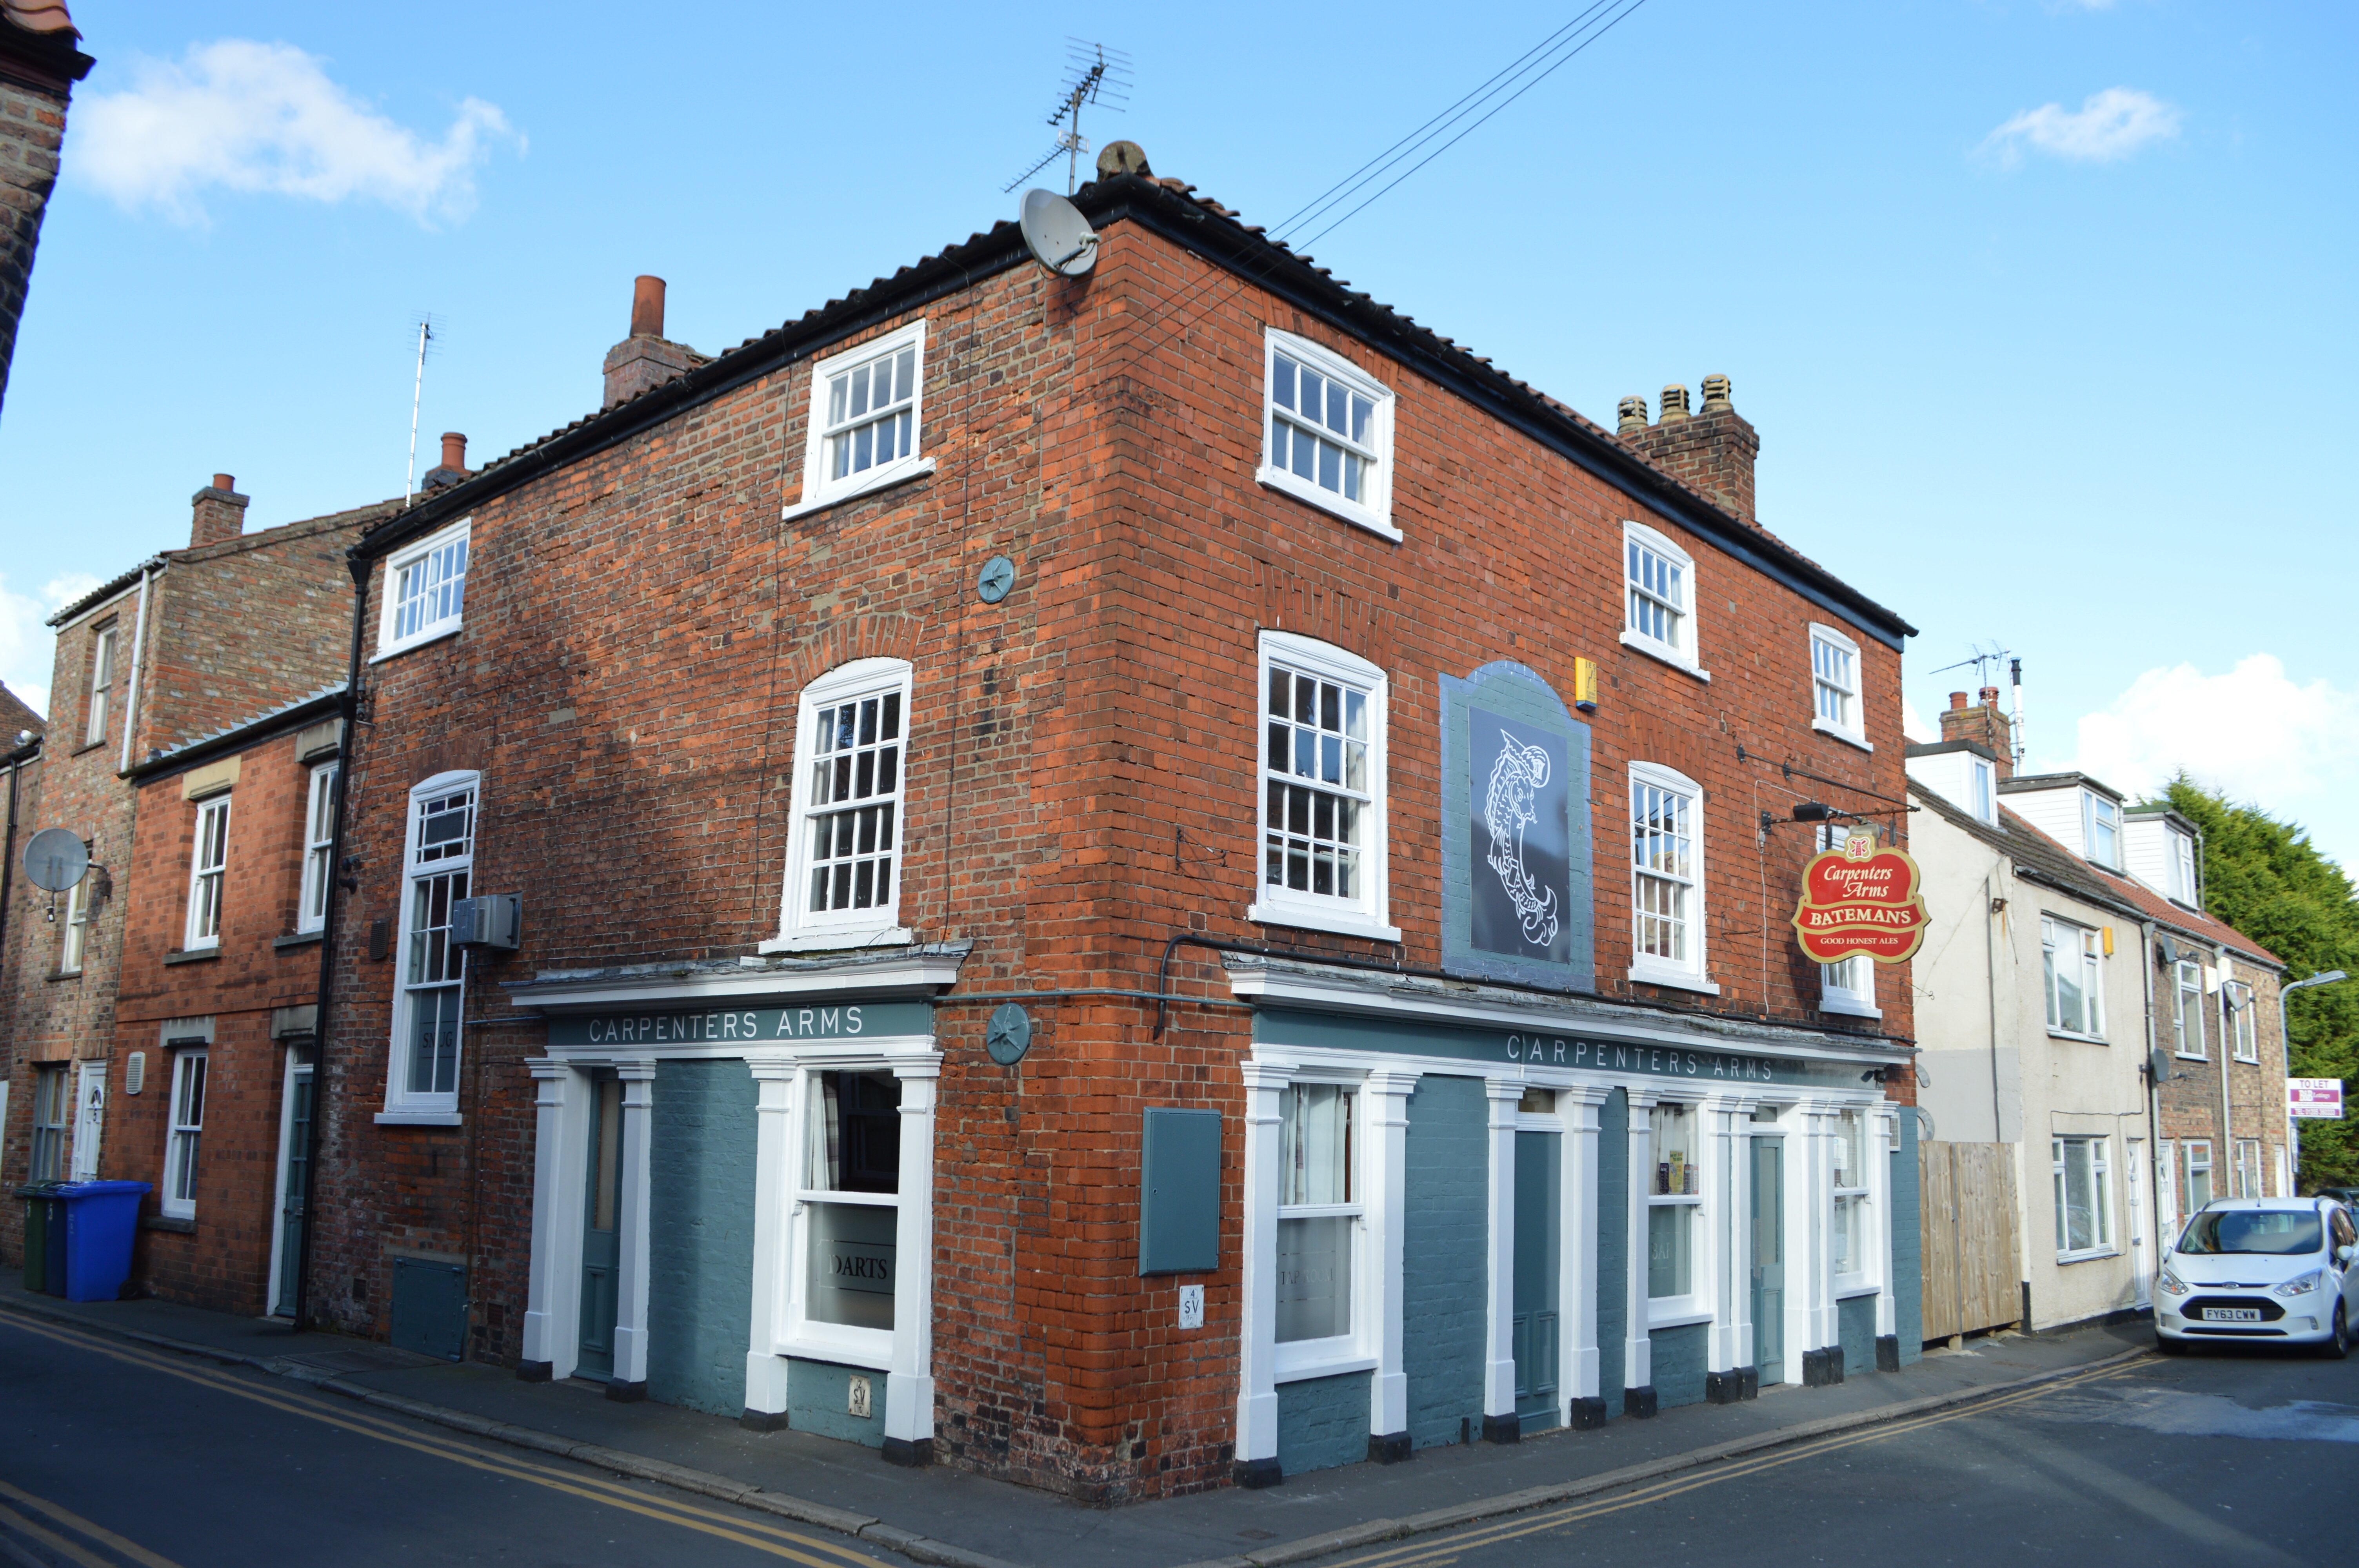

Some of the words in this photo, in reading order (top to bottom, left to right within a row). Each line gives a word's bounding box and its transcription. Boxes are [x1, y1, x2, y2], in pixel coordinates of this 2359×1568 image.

[1824, 865, 1893, 888] Carpenters
[1843, 882, 1889, 897] Arms
[1809, 908, 1911, 926] BATEMANS
[590, 1013, 757, 1042] CARPENTERS
[776, 1007, 862, 1036] ARMS
[1507, 1035, 1696, 1074] CARPENTERS
[1714, 1057, 1771, 1080] ARMS
[828, 1255, 887, 1279] DARTS
[1281, 1270, 1300, 1285] TAP
[2207, 1310, 2233, 1319] FY63
[2236, 1310, 2255, 1319] CWW
[858, 1380, 861, 1388] 2
[854, 1388, 865, 1404] SV
